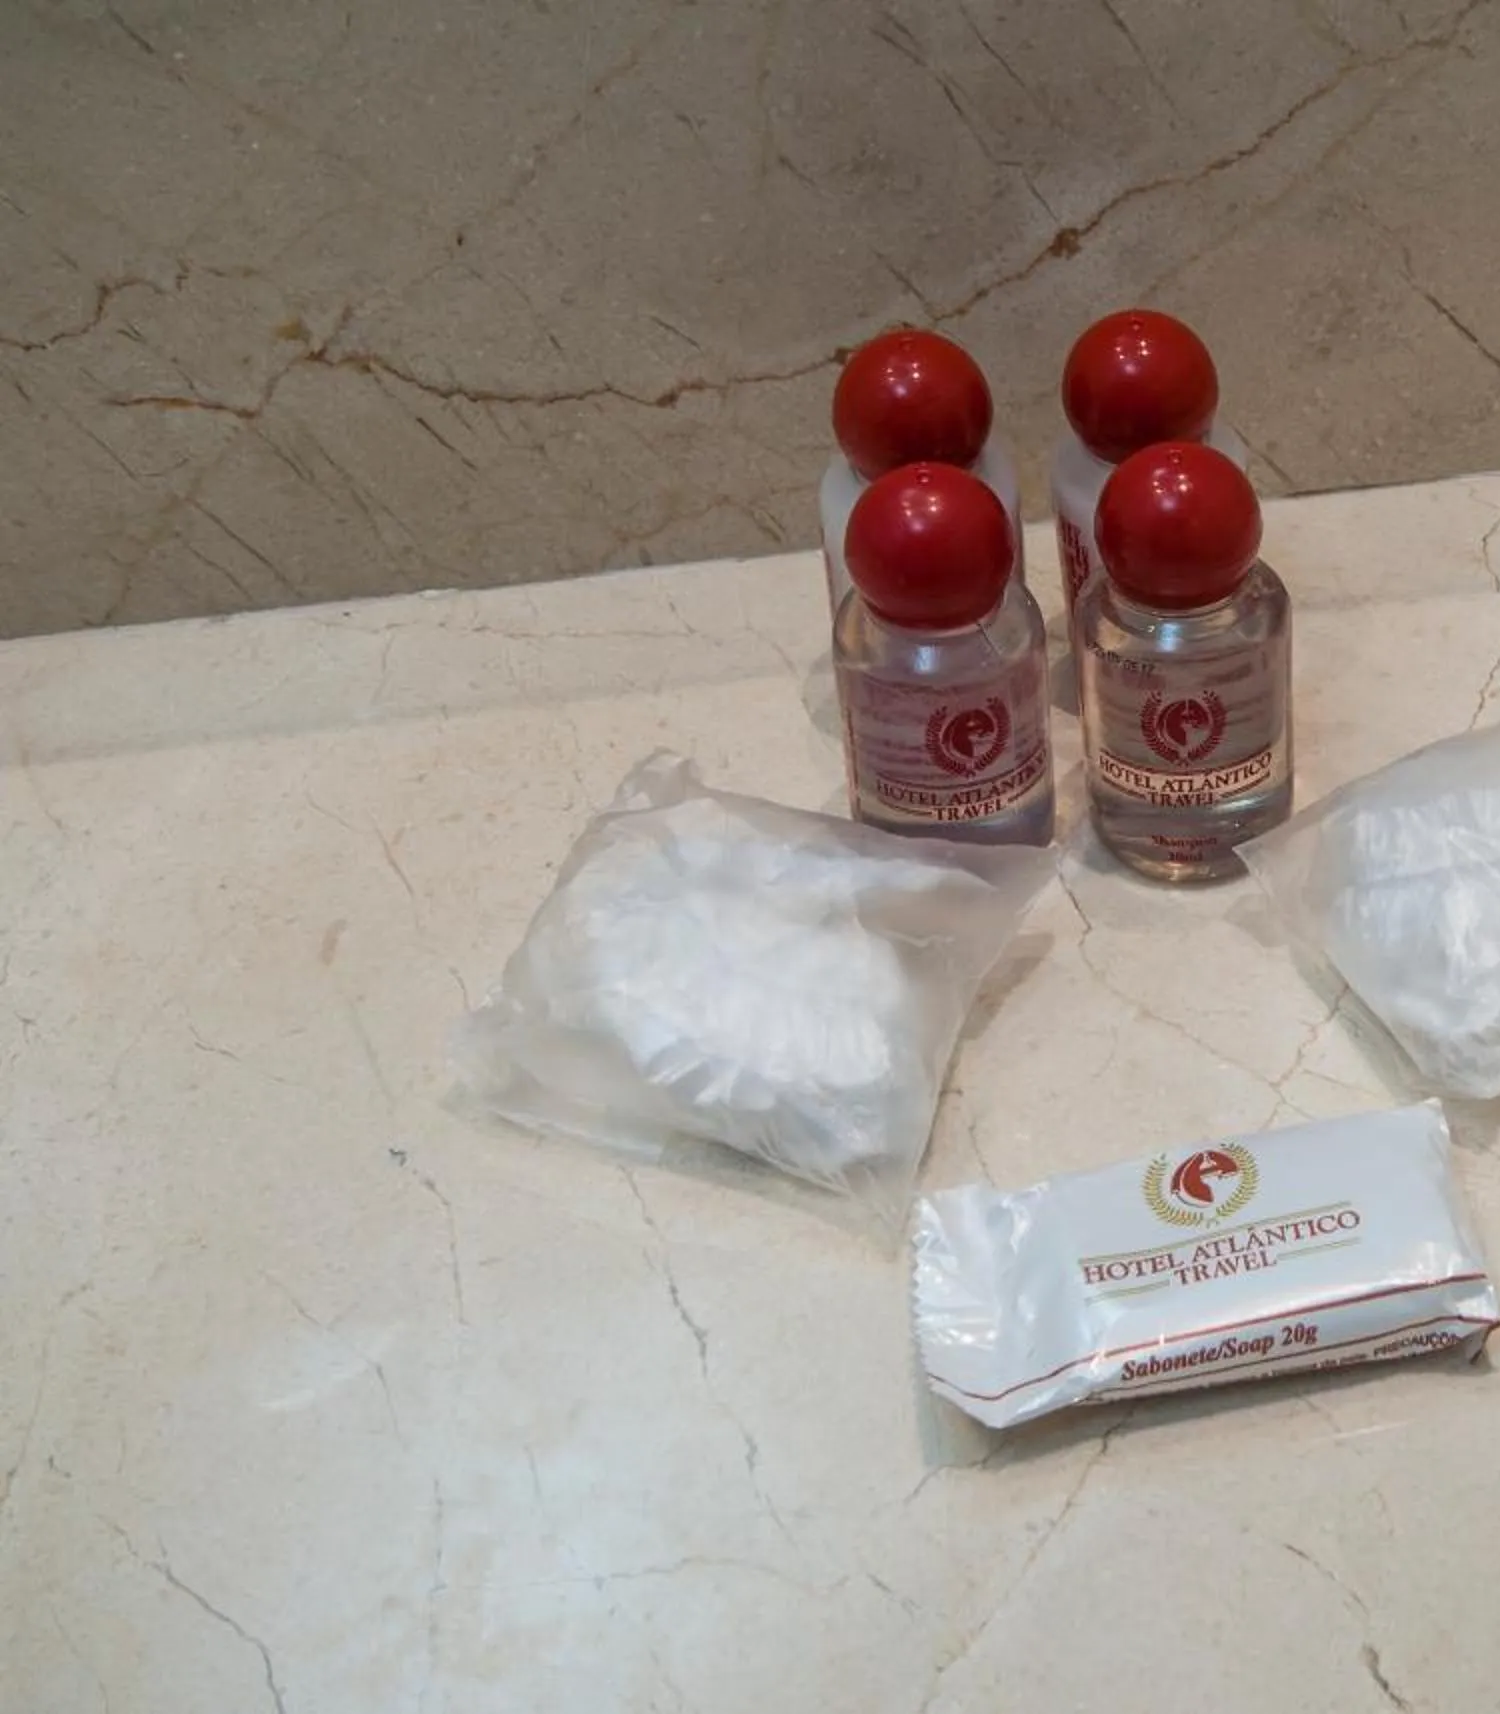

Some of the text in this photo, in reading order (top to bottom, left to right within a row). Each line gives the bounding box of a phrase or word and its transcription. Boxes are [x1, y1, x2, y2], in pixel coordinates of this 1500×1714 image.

[1098, 754, 1156, 790] HOTEL
[875, 778, 941, 806] HOTEL
[1148, 791, 1215, 808] TRAVEL
[932, 802, 1005, 821] TRAVEL
[1082, 1208, 1361, 1285] HOTEL ATLÂNTICO
[1173, 1249, 1278, 1287] TRAVEL
[1120, 1334, 1274, 1381] Sabonete/Soap
[1280, 1323, 1319, 1346] 20g
